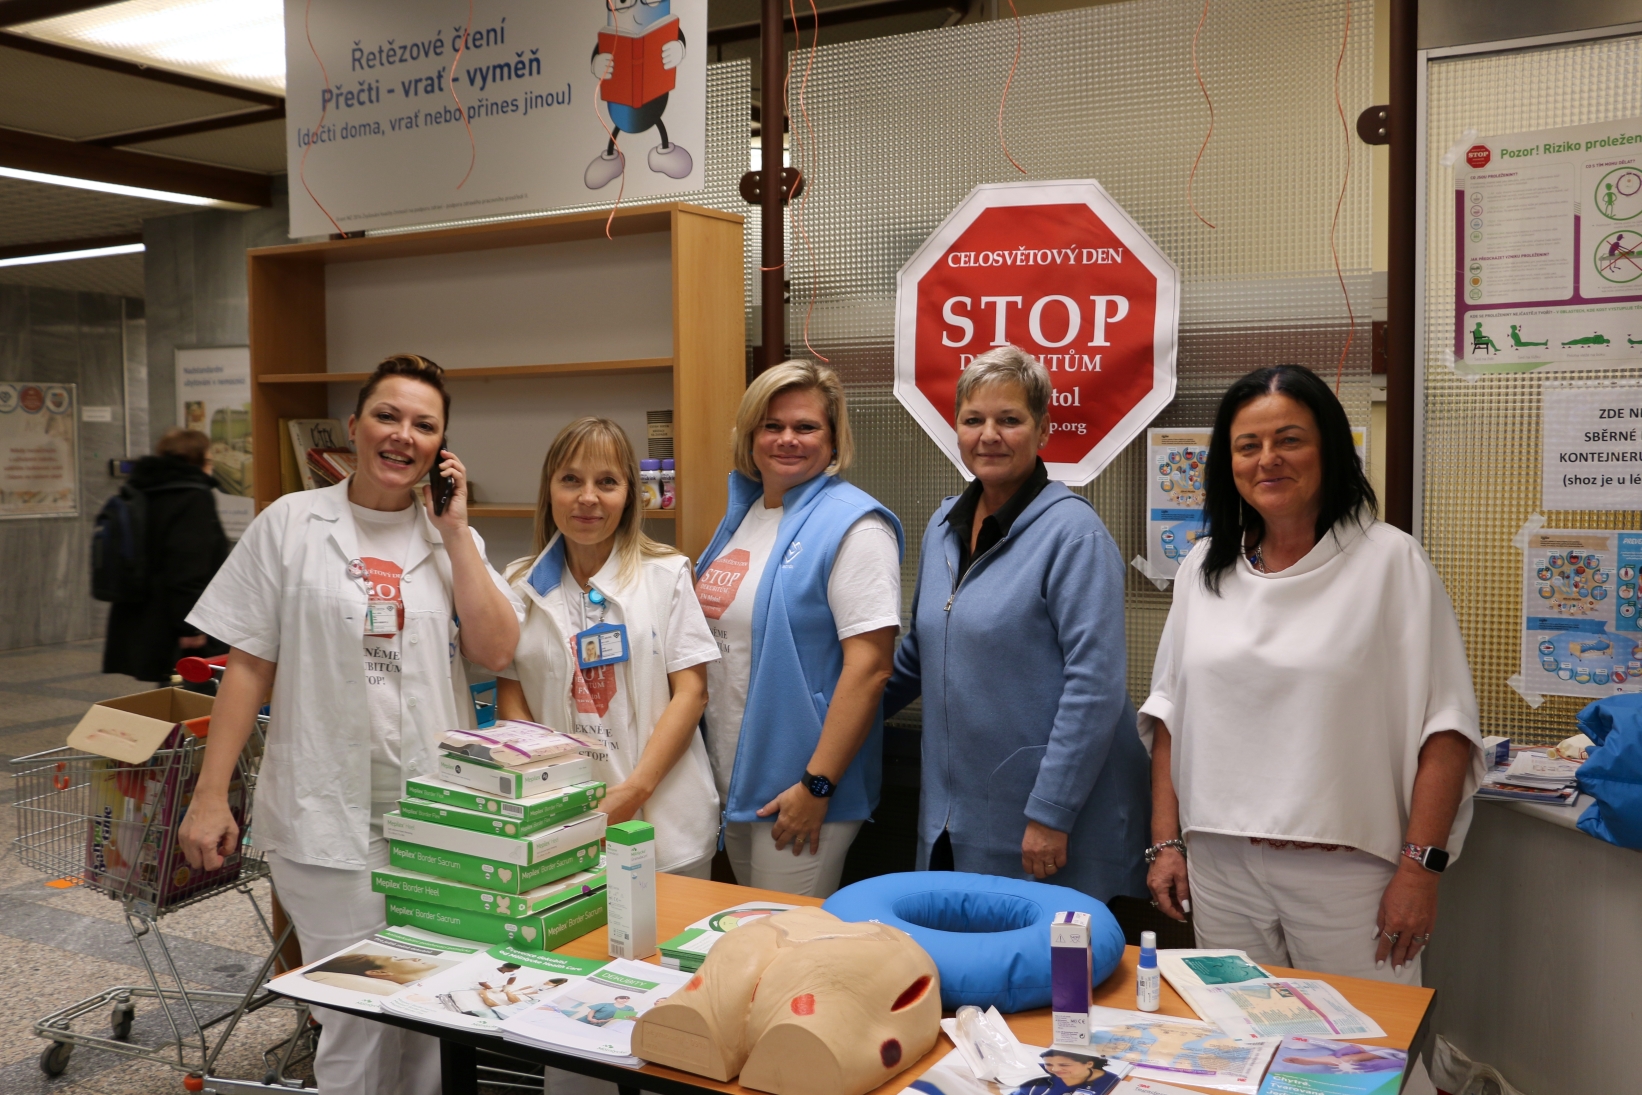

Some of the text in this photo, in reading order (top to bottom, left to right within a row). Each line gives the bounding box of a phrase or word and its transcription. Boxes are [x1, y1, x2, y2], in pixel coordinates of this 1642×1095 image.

[351, 17, 506, 72] Řetězové čtení
[321, 79, 380, 112] Přečti
[401, 66, 446, 98] vrať
[466, 48, 541, 92] vyměň
[297, 82, 572, 148] (dočti doma, vrať nebo přines jinou)
[1468, 151, 1489, 159] STOP
[1500, 133, 1642, 160] Pozor! Riziko proležen
[947, 244, 1123, 268] CELOSVĚTOVÝ DEN
[941, 294, 1130, 348] STOP
[959, 348, 1103, 372] DITŮM
[1599, 407, 1642, 419] ZDE N
[1584, 428, 1637, 442] SBĚRNÉ
[1563, 473, 1642, 487] (shoz je u lé
[701, 568, 741, 587] STOP
[363, 645, 400, 661] NĚME
[506, 946, 568, 965] Prevence dekubitů
[543, 961, 566, 969] Health
[601, 972, 647, 986] DEKUBITY
[1272, 1075, 1312, 1087] Chytré.
